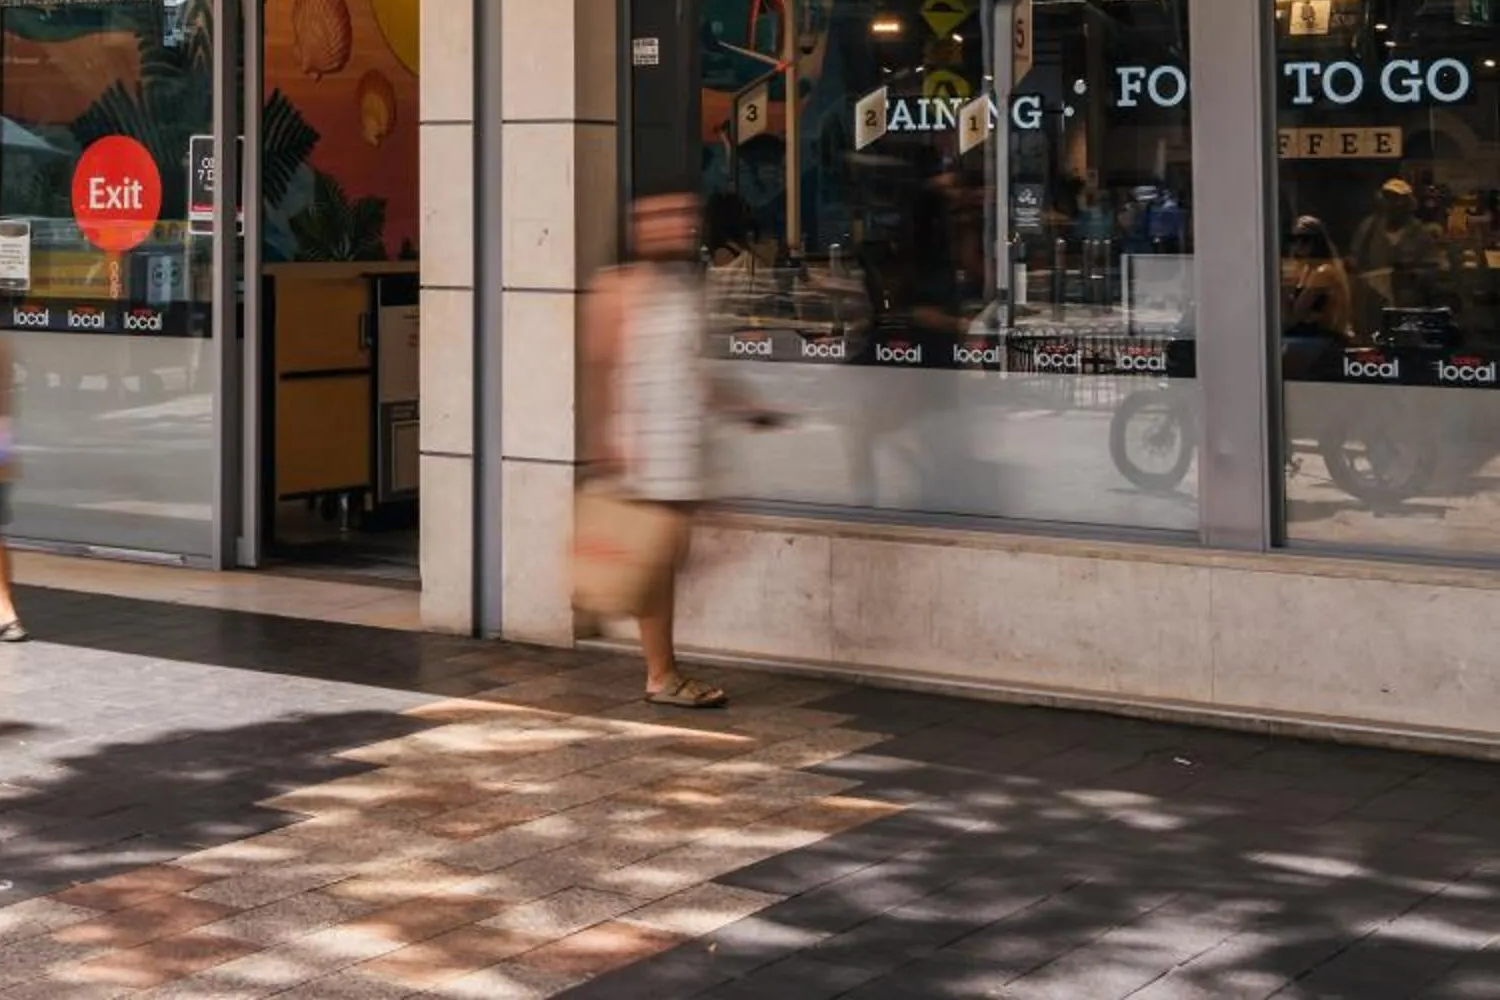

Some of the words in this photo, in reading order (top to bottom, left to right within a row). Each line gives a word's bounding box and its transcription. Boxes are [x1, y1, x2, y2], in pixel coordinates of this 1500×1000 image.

[1115, 65, 1188, 107] FO
[1283, 61, 1364, 104] TO
[1380, 58, 1470, 103] GO
[745, 104, 758, 122] 3
[864, 109, 877, 127] 2
[968, 115, 979, 132] 1
[1278, 131, 1393, 156] FFEE
[88, 177, 144, 210] Exit
[13, 308, 50, 327] local
[67, 309, 105, 328] local
[123, 312, 163, 330] local
[729, 335, 773, 355] local
[801, 338, 846, 358] local
[875, 343, 922, 363] local
[953, 344, 1000, 364] local
[1032, 348, 1082, 368] local
[1116, 351, 1167, 371] local
[1343, 356, 1399, 378] local
[1438, 359, 1496, 382] local
